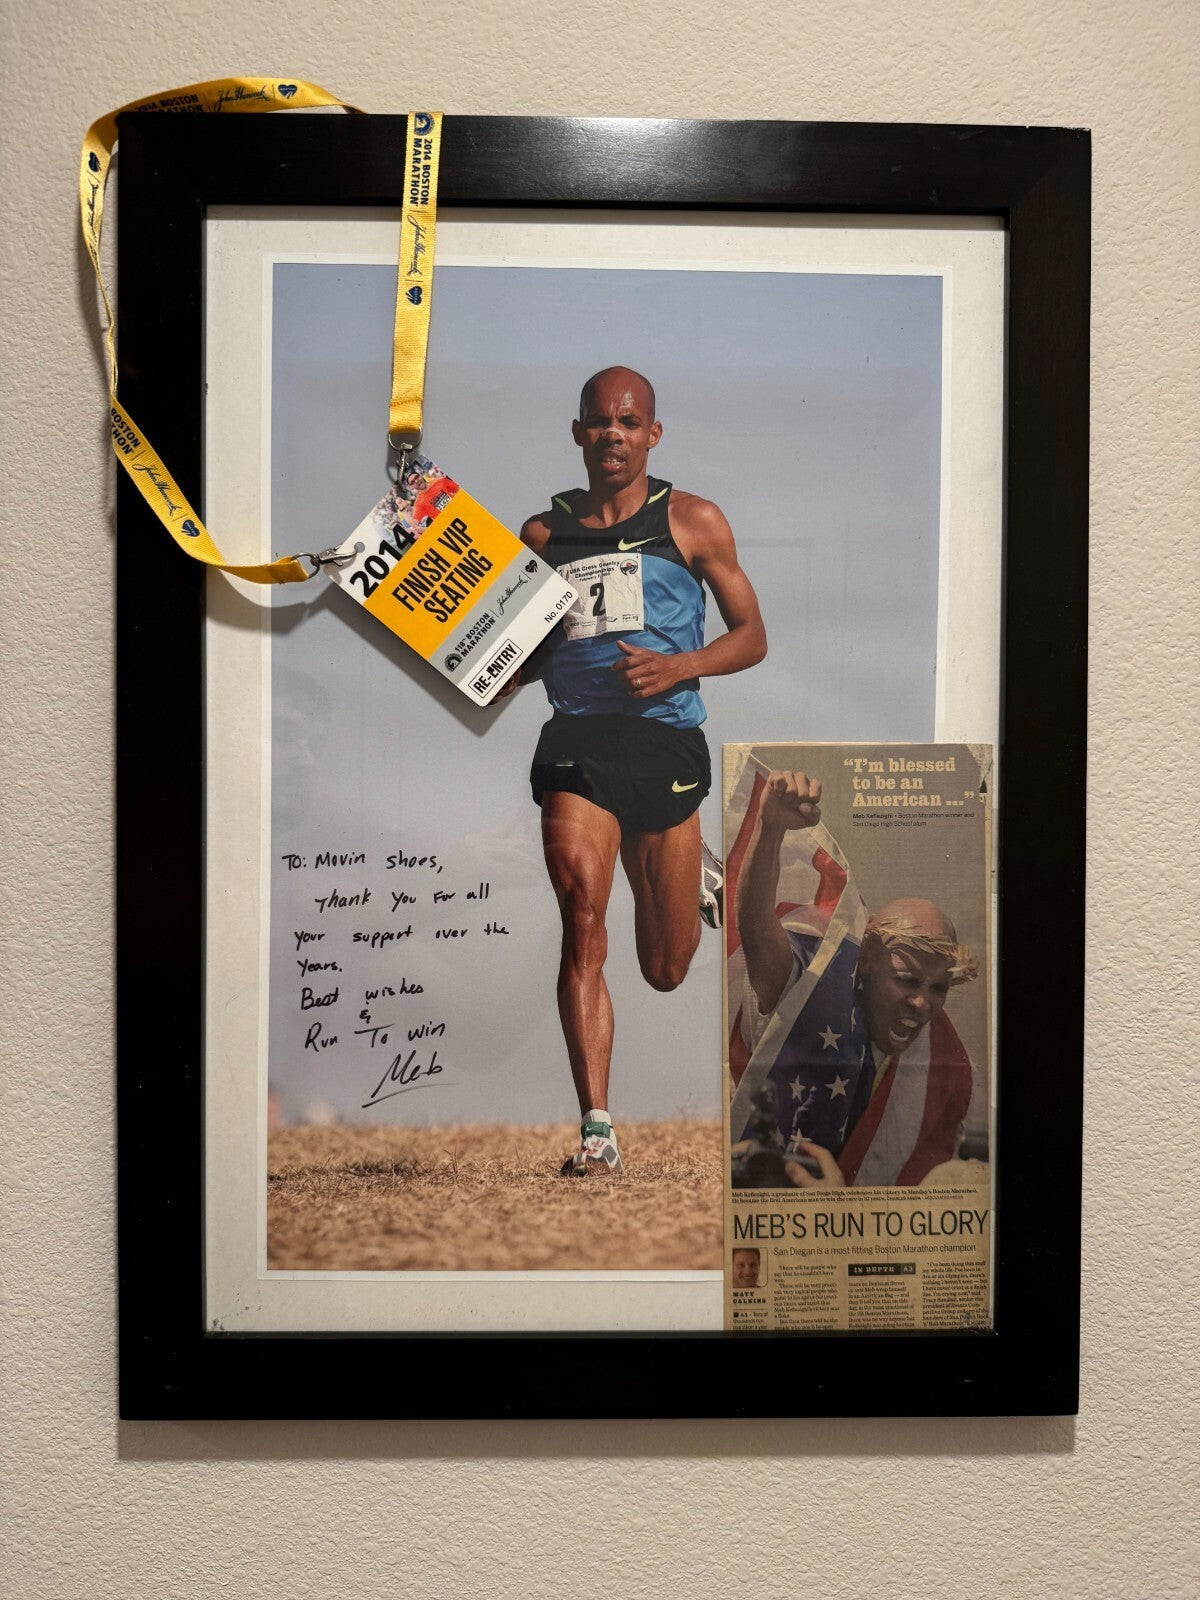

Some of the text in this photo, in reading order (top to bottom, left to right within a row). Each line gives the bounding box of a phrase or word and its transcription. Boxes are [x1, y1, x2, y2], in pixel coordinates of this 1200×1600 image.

[160, 94, 199, 107] BOSTON
[410, 138, 422, 207] MARATHON
[420, 138, 433, 205] 2014 BOSTON
[350, 524, 417, 598] 2014
[392, 518, 473, 612] FINISH VIP
[424, 549, 493, 622] SEATING
[590, 583, 606, 617] 2
[544, 591, 573, 623] No. 0170
[461, 617, 496, 658] MARATHON
[466, 613, 490, 639] BOSTON
[473, 643, 517, 693] RE-ENTRY
[888, 757, 956, 772] blessed
[852, 775, 924, 790] to be an
[852, 792, 942, 807] American
[880, 820, 893, 828] High
[466, 882, 490, 900] all
[353, 925, 413, 948] support
[435, 928, 468, 939] over
[484, 922, 509, 936] the
[301, 987, 339, 1010] Best
[304, 1022, 337, 1052] Run
[814, 1211, 864, 1238] RUN
[871, 1211, 903, 1237] TO
[910, 1209, 989, 1236] GLORY
[774, 1247, 788, 1256] San
[789, 1246, 816, 1257] Diegan
[817, 1246, 822, 1255] is
[831, 1246, 849, 1255] most
[851, 1245, 873, 1256] fitting
[875, 1244, 900, 1254] Boston
[903, 1243, 939, 1253] Marathon
[940, 1243, 976, 1254] champion
